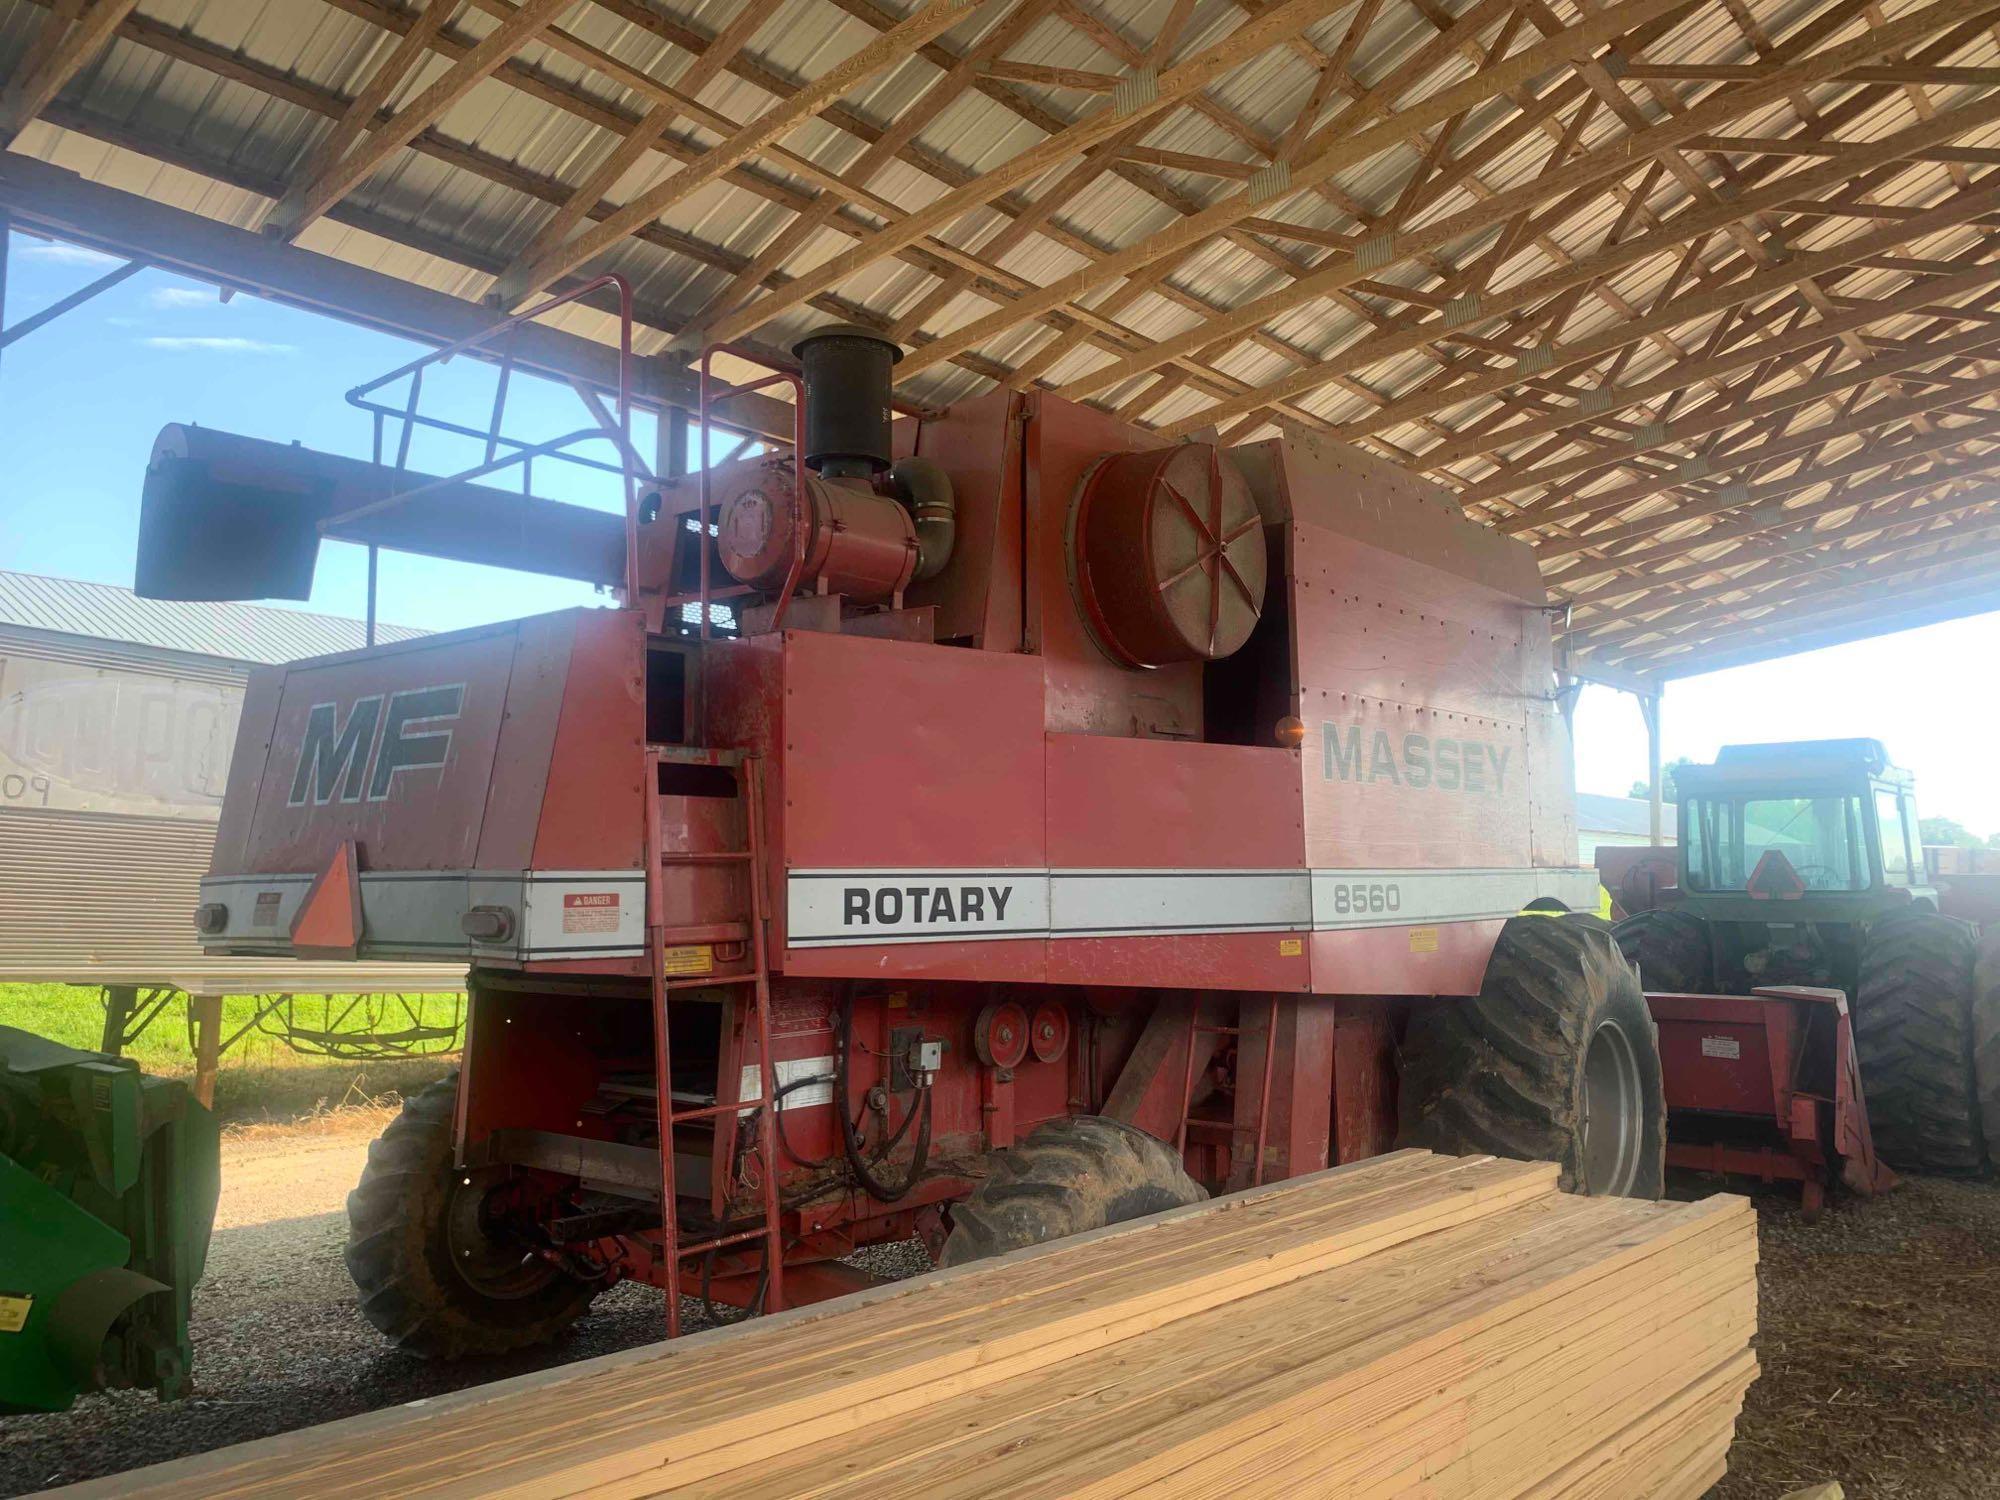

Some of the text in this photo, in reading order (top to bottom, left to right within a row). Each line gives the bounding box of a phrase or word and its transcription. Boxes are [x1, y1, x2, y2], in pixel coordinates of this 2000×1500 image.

[287, 682, 466, 808] MF
[1321, 720, 1512, 794] MASSEY
[583, 895, 611, 905] DANGER
[843, 886, 1013, 925] ROTARY
[1334, 884, 1400, 913] 8560
